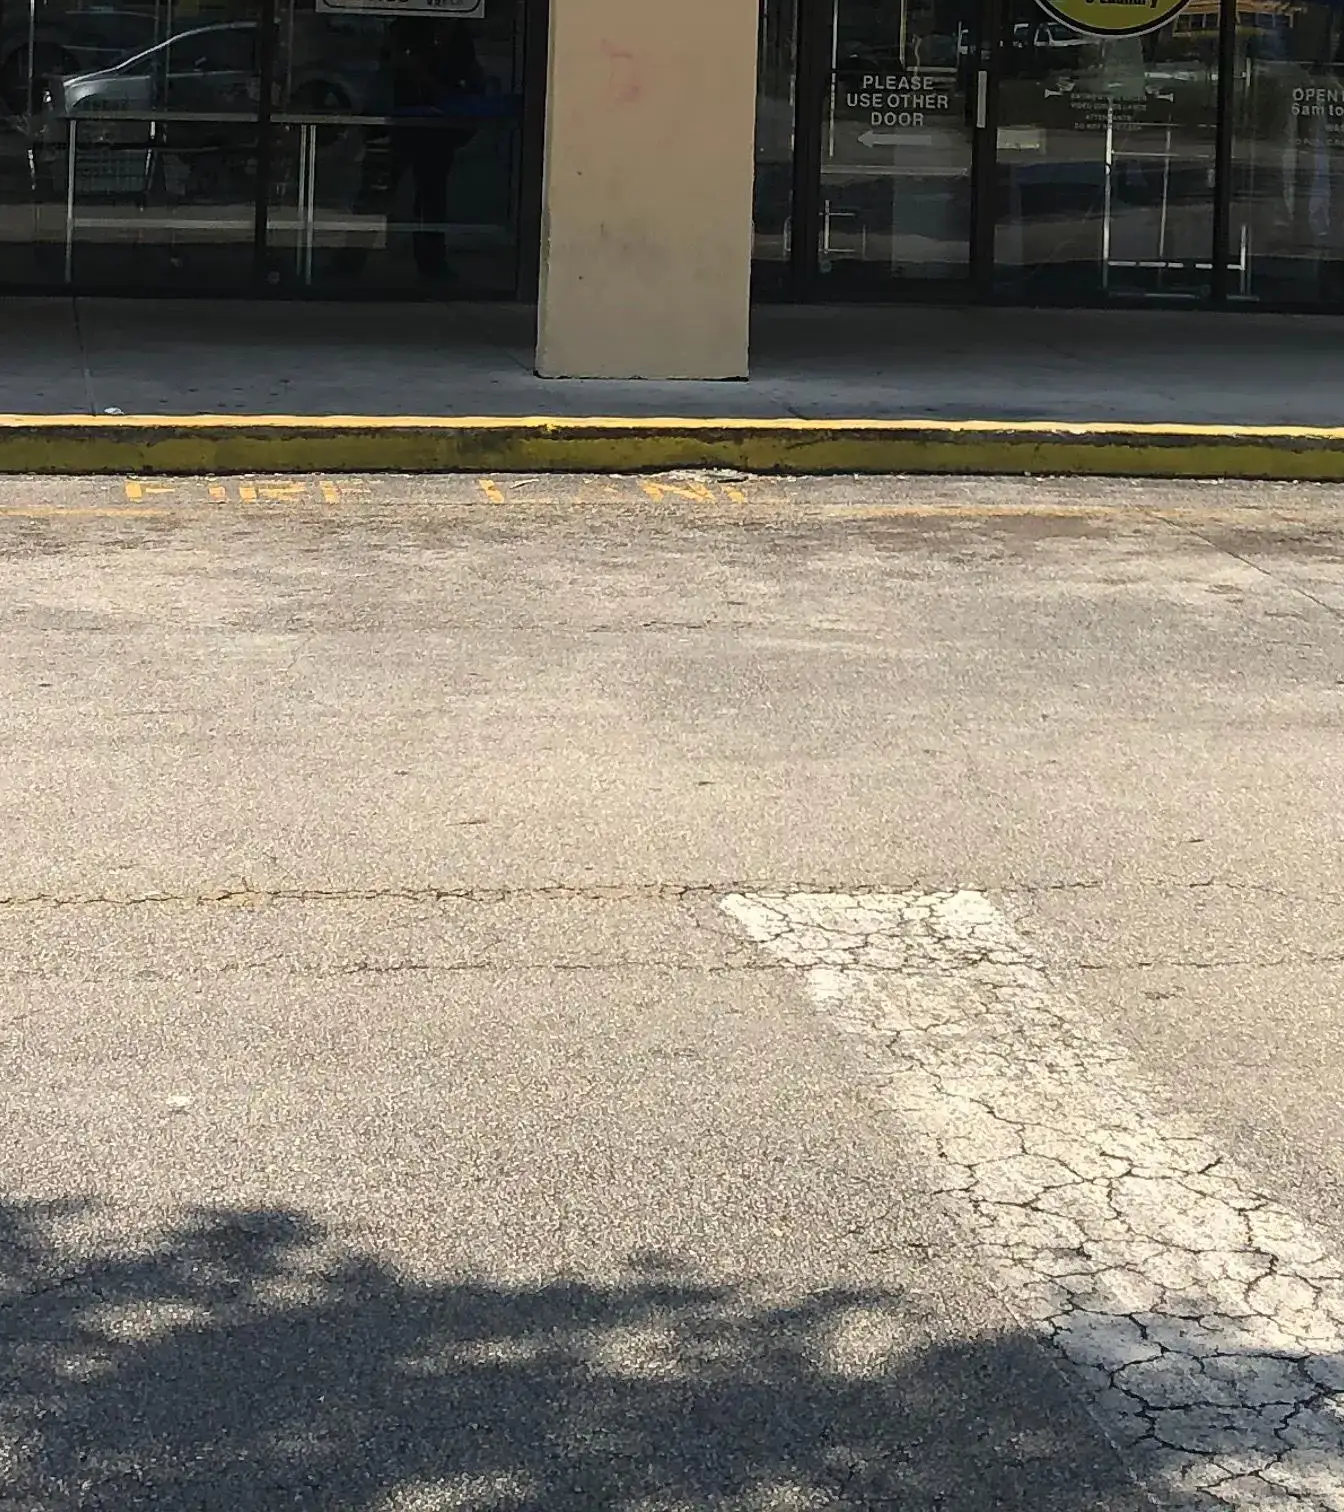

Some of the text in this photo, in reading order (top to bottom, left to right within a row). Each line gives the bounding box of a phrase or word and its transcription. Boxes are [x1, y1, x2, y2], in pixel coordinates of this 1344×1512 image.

[862, 75, 935, 90] PLEASE
[846, 92, 949, 109] USE OTHER
[1291, 87, 1339, 103] OPEN
[1290, 102, 1325, 116] 6am
[1328, 104, 1344, 117] to
[871, 112, 924, 127] DOOR
